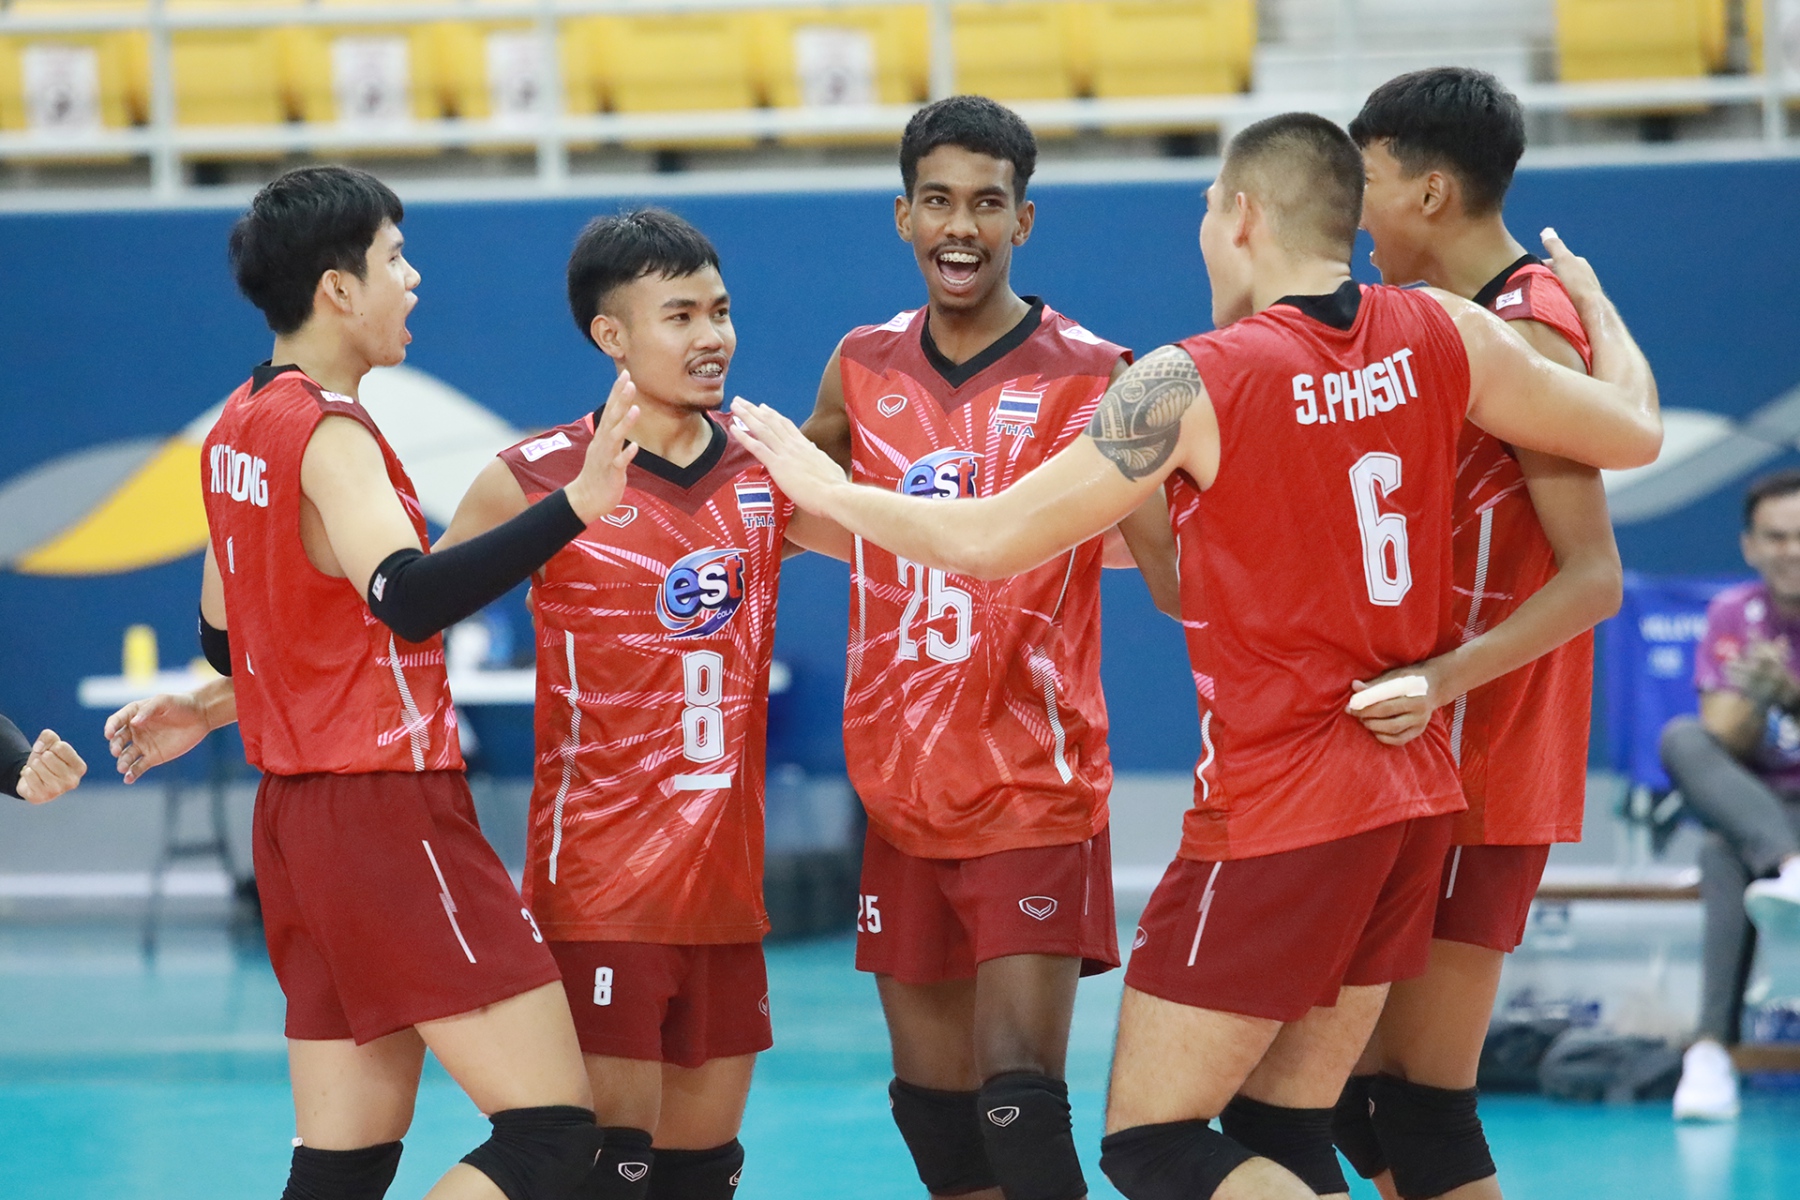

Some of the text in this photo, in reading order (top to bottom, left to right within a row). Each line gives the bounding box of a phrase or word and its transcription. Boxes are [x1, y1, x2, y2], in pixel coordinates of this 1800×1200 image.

[1292, 348, 1418, 425] S.PHISIT
[525, 439, 565, 457] PEA
[994, 423, 1036, 439] THA
[902, 458, 978, 500] est
[743, 515, 776, 527] THA
[1349, 451, 1413, 607] 6
[666, 554, 745, 616] est
[717, 608, 733, 620] COLA
[896, 554, 973, 664] 25
[681, 649, 725, 764] 8
[593, 966, 614, 1006] 8
